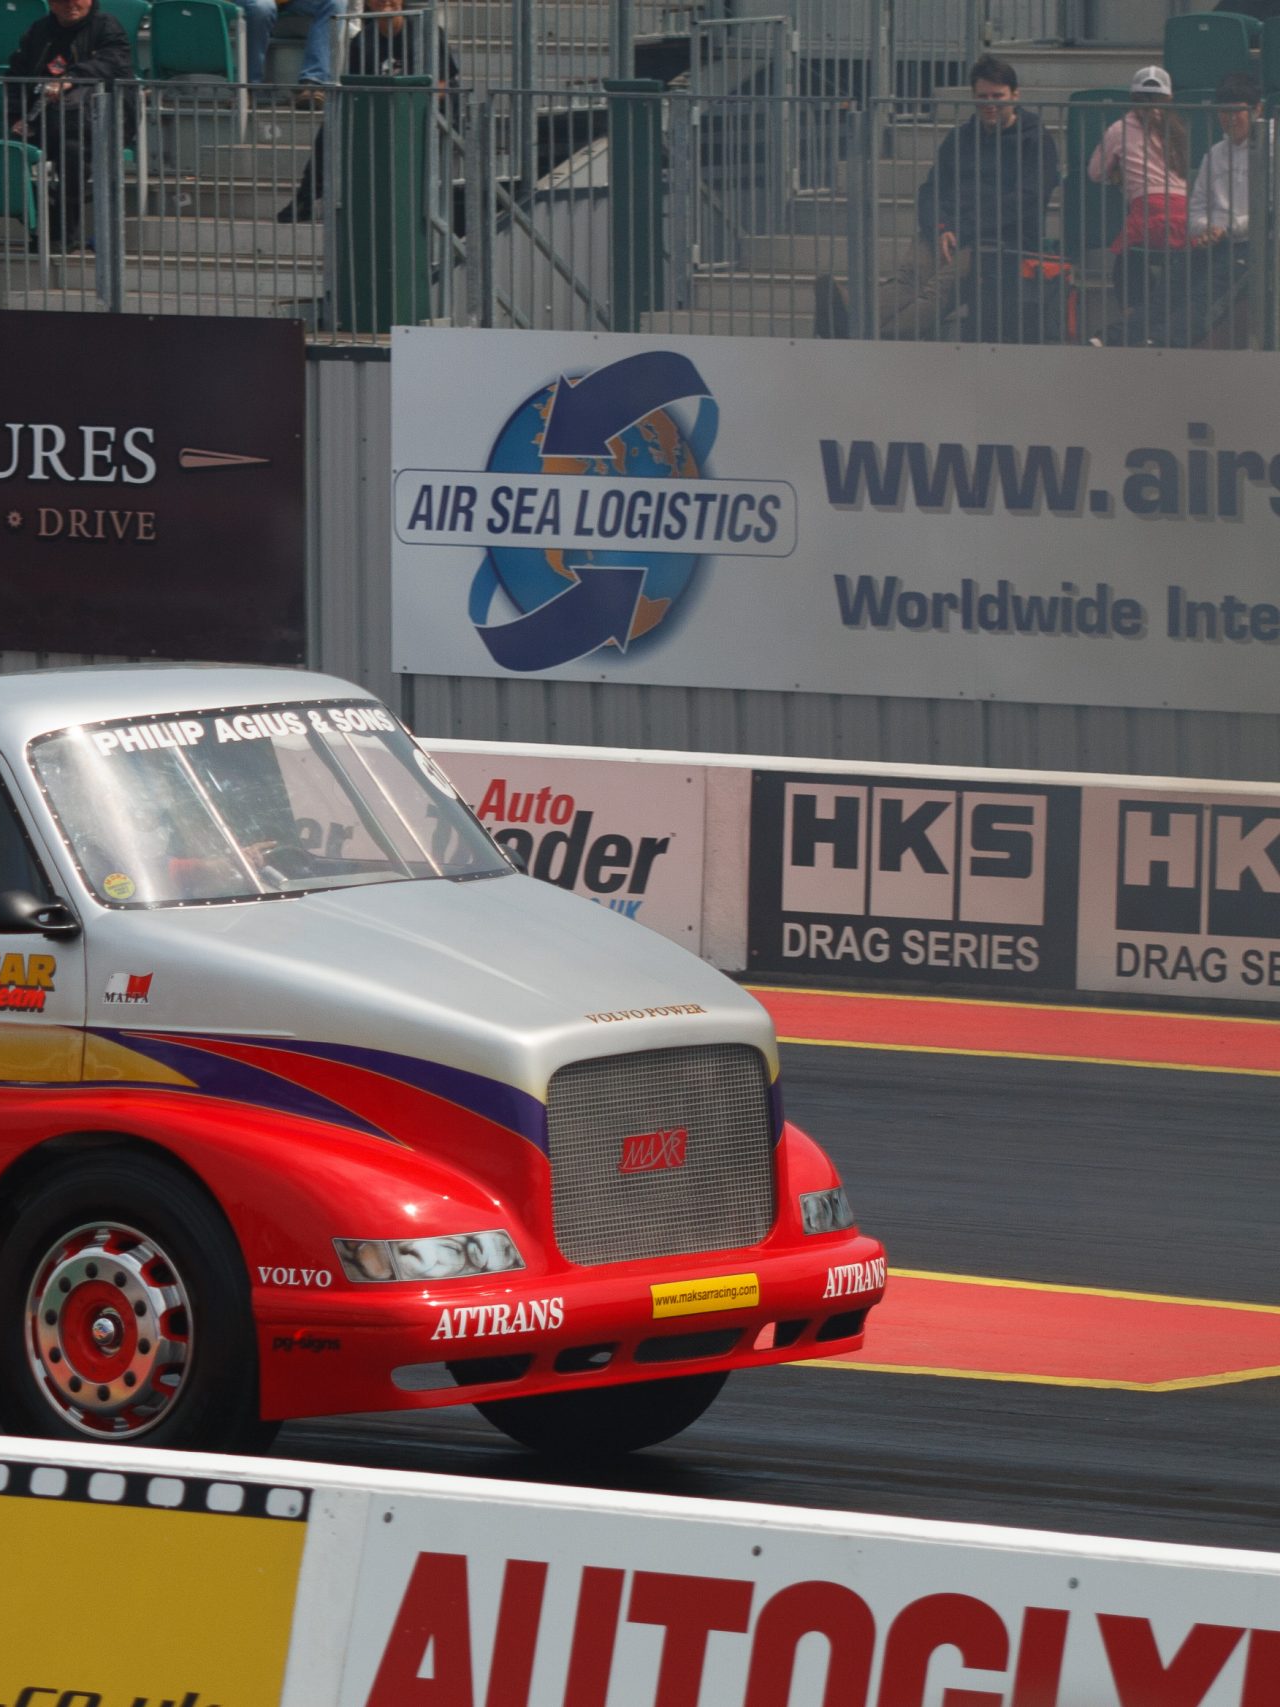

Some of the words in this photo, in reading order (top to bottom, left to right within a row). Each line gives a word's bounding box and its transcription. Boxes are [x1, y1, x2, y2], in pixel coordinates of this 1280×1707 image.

[819, 422, 1280, 520] www.air
[38, 508, 157, 540] DRIVE
[408, 484, 477, 532] AIR
[487, 486, 561, 535] SEA
[574, 489, 782, 543] LOGISTICS
[833, 574, 1145, 636] Worldwide
[93, 719, 205, 757] PHILIP
[215, 710, 310, 744] AGIUS
[306, 709, 331, 735] &
[329, 708, 396, 734] SONS
[477, 779, 575, 825] Auto
[791, 793, 1036, 879] HKS
[782, 922, 890, 963] DRAG
[901, 929, 1040, 972] SERIES
[1116, 941, 1227, 984] DRAG
[585, 1009, 645, 1025] VOLVO
[644, 1004, 708, 1018] POWER
[258, 1266, 332, 1287] VOLVO
[654, 1283, 757, 1306] www.maksarracing.com
[822, 1257, 886, 1299] ATTRANS
[430, 1297, 564, 1340] ATTRANS
